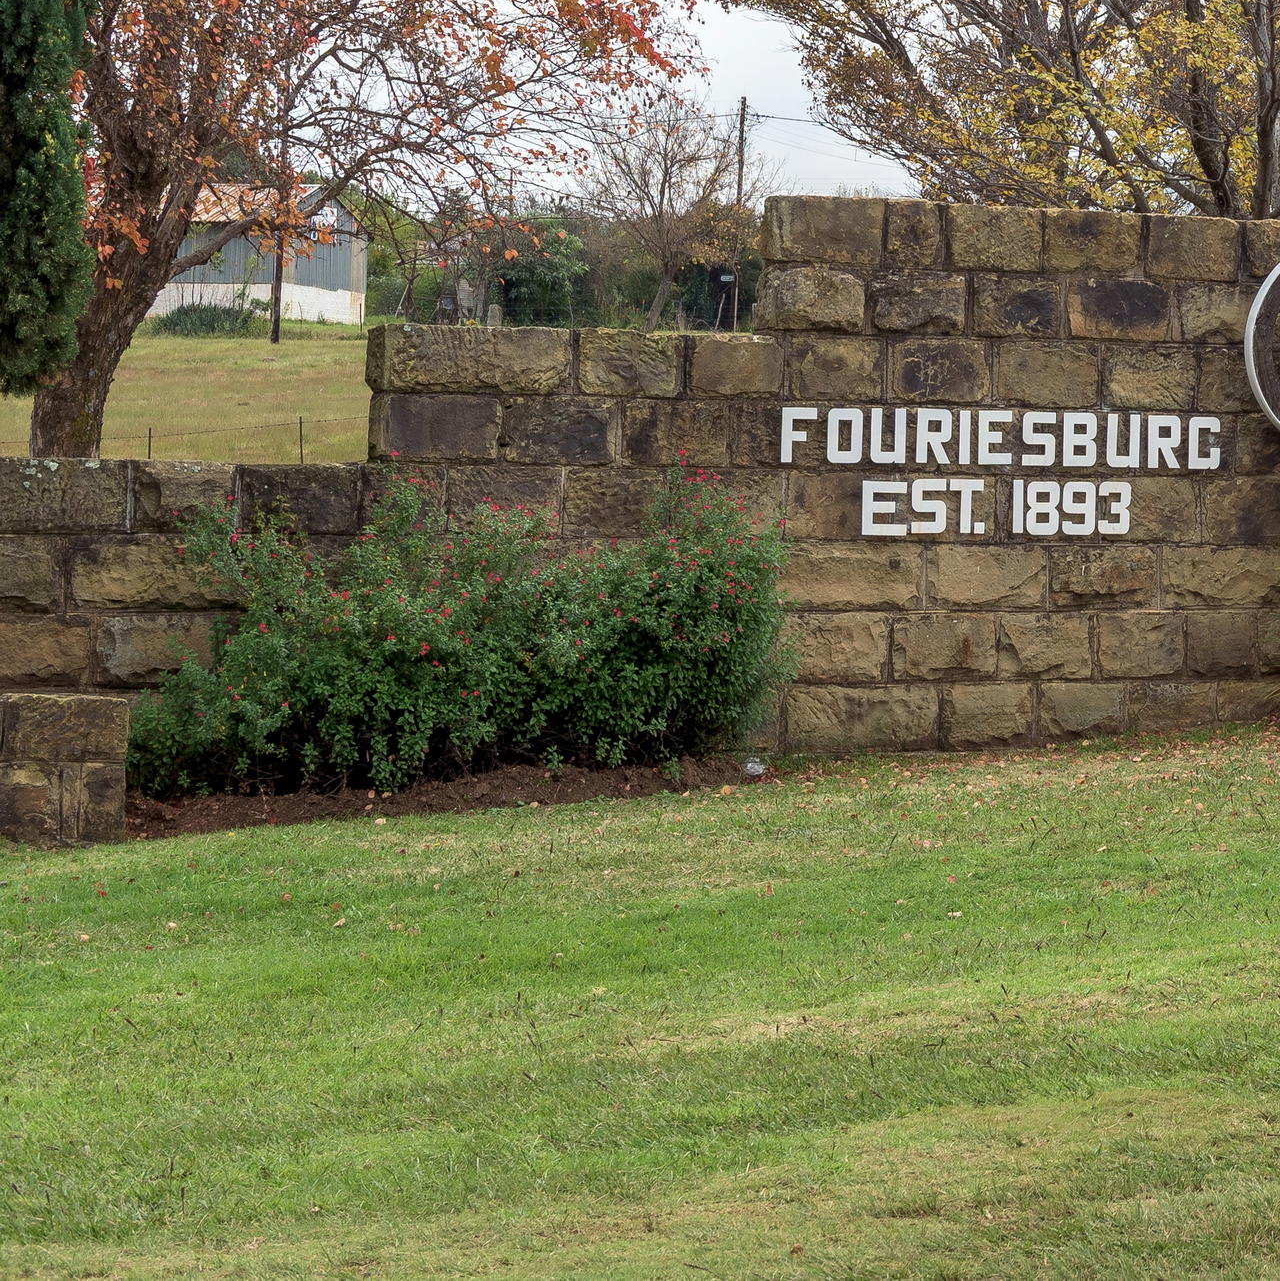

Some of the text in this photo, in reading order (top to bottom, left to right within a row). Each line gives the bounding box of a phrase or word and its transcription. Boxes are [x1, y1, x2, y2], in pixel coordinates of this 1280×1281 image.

[781, 407, 1221, 470] FOURIESBURG
[862, 478, 1132, 536] EST. 1893
